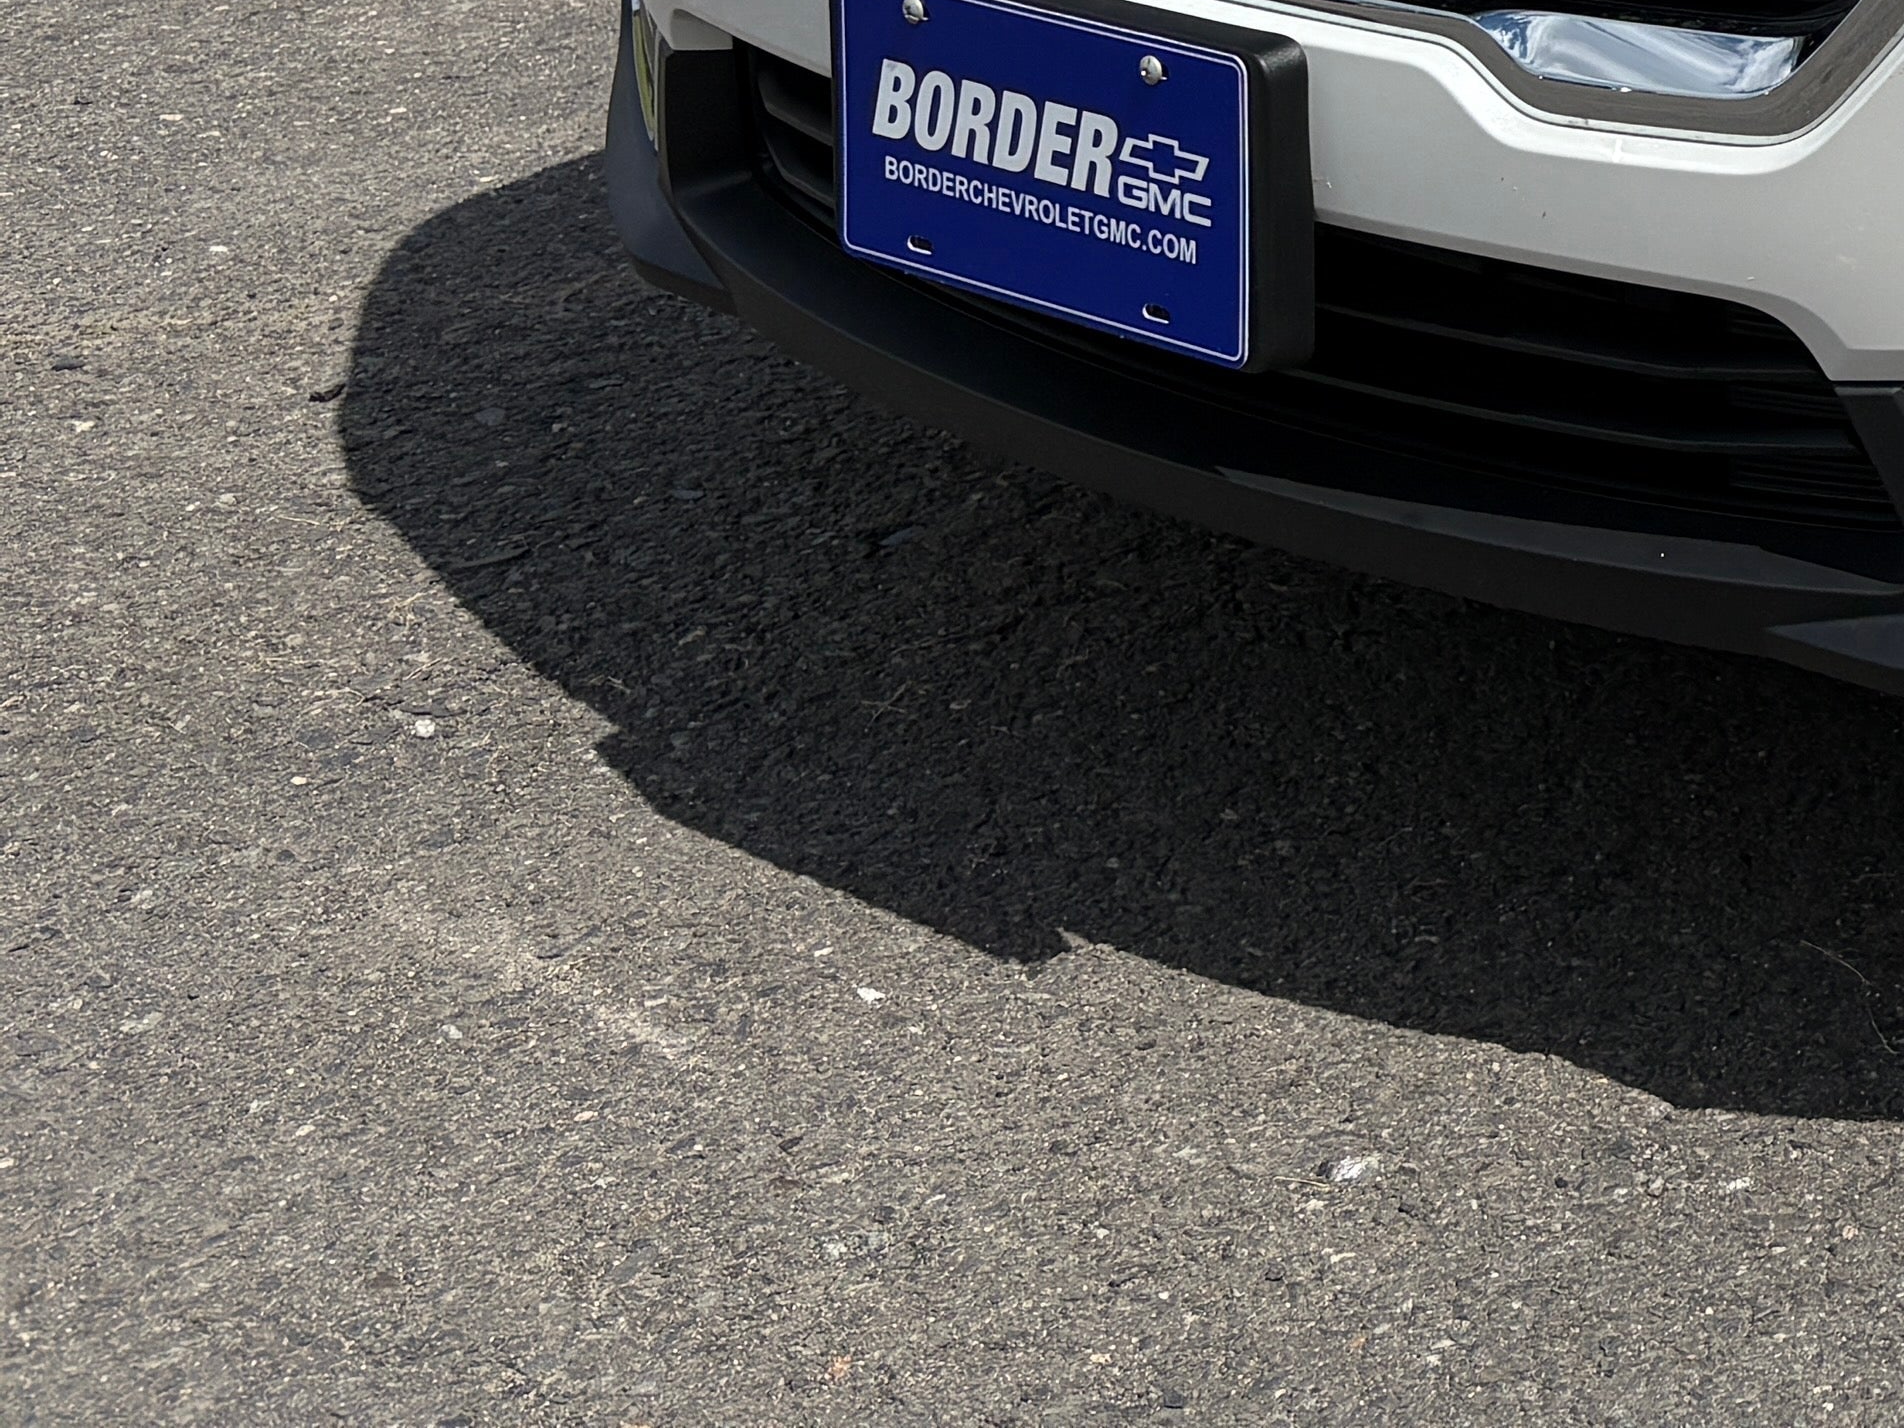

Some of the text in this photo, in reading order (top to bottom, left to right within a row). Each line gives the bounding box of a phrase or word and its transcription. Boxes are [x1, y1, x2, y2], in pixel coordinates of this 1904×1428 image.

[872, 58, 1212, 228] BORDER GMC
[884, 156, 1197, 265] BORDERCHEVROLETGMC.COM
